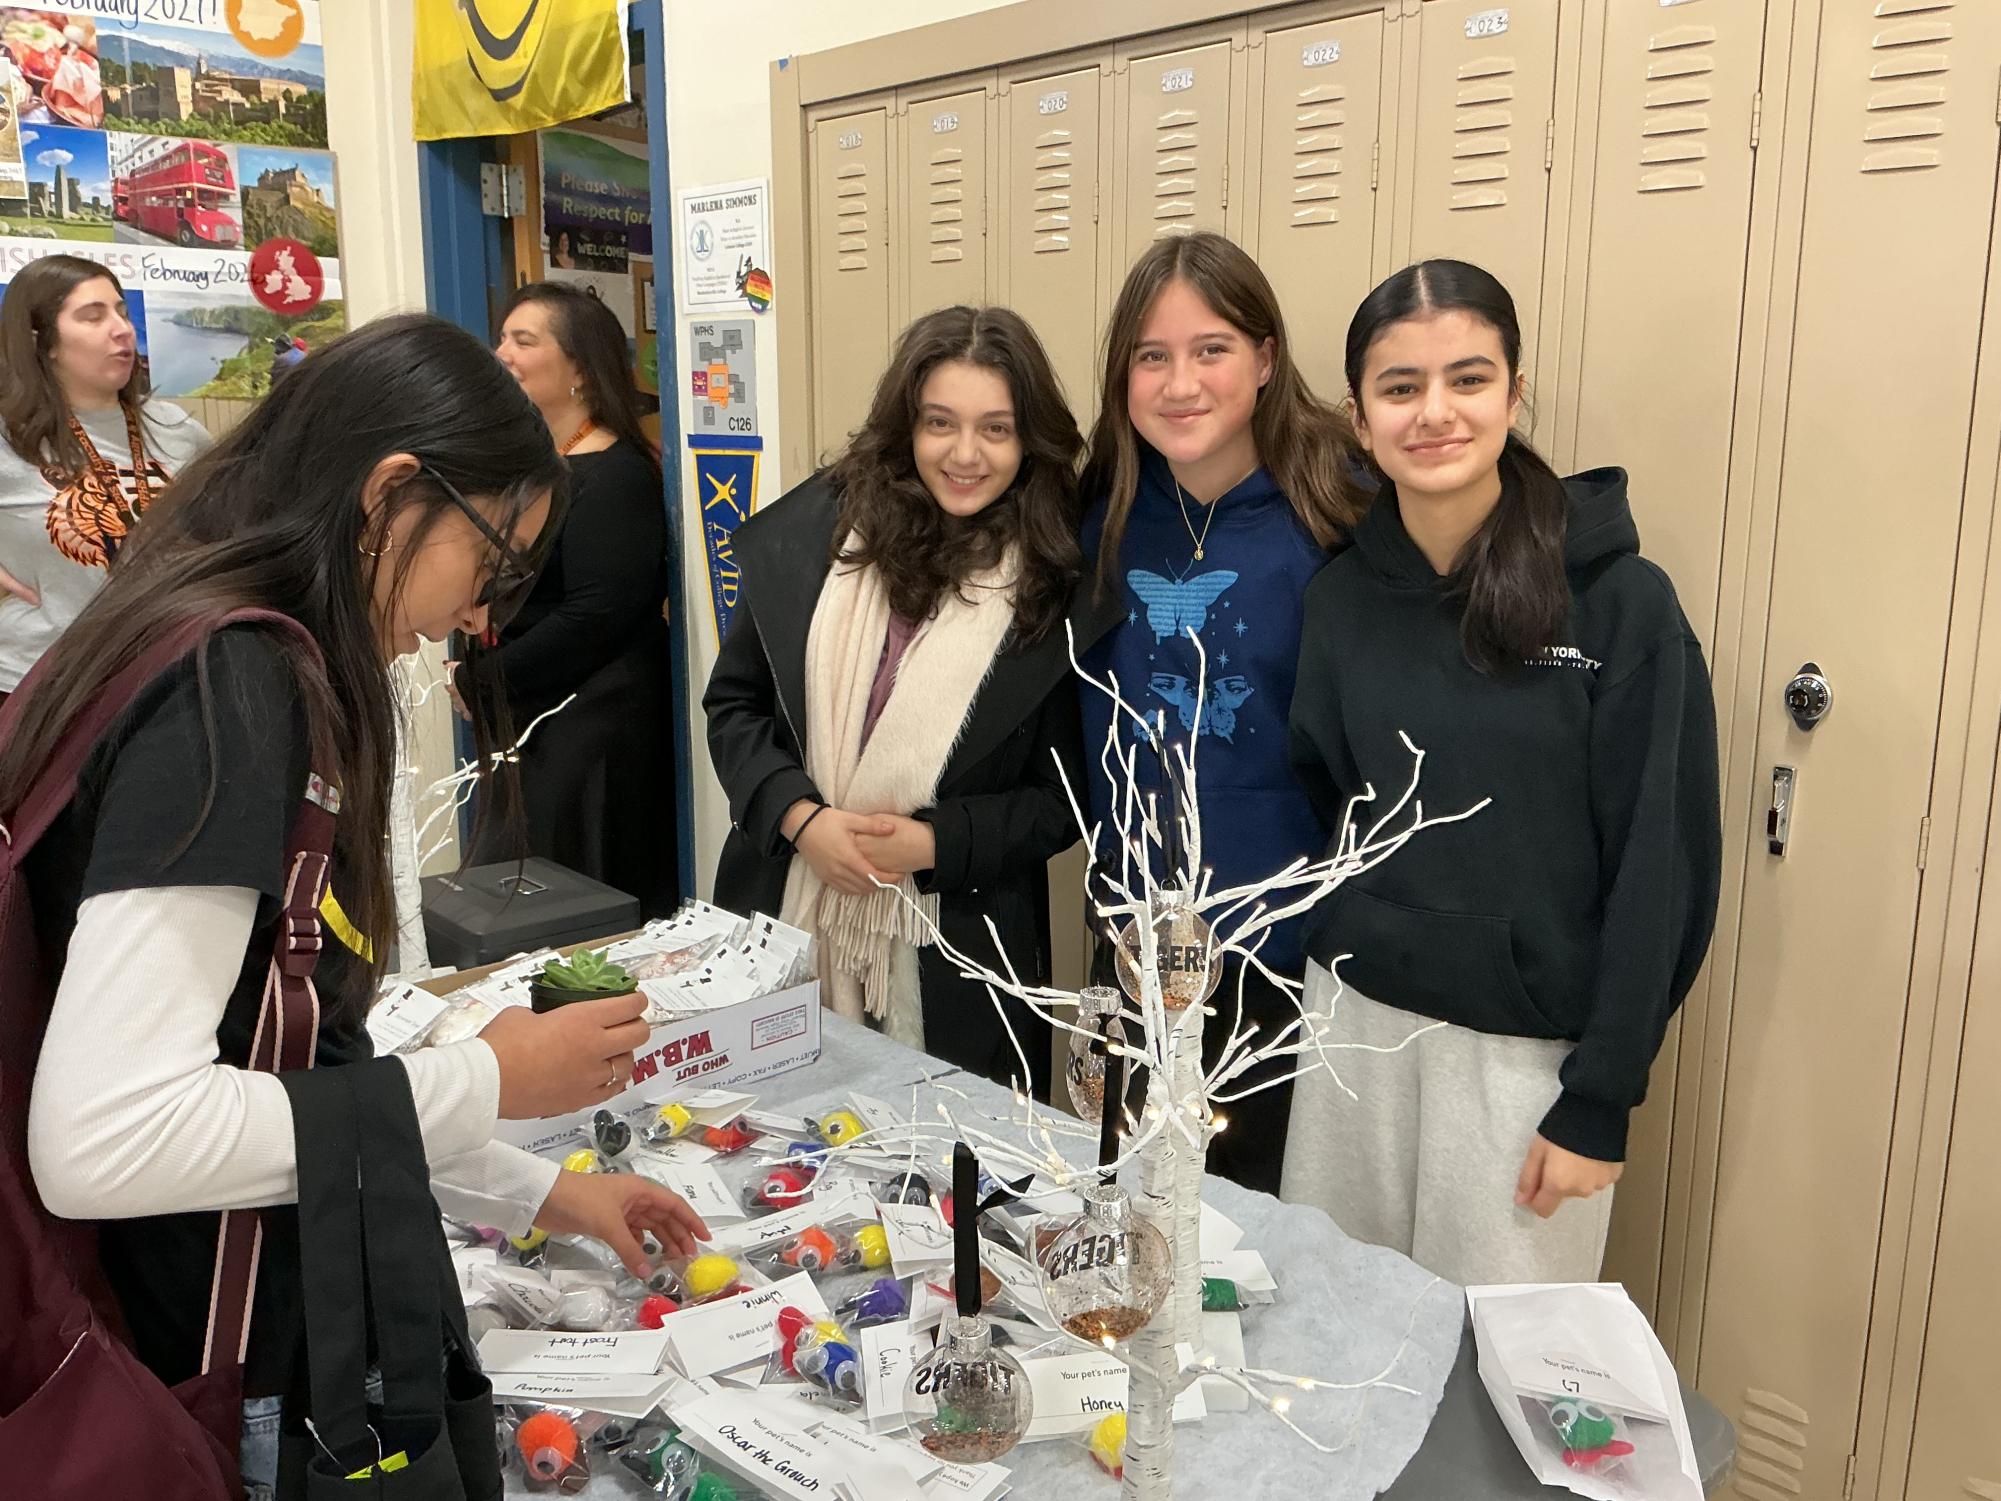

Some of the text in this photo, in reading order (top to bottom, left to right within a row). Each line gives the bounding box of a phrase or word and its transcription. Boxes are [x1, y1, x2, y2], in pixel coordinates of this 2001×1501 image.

[1478, 16, 1505, 34] 023
[1312, 47, 1335, 63] 022
[1170, 75, 1189, 90] 021
[1046, 97, 1063, 112] 020
[940, 117, 956, 130] 019
[560, 172, 608, 196] Please
[562, 197, 646, 226] Respect for
[690, 194, 758, 215] MARLENA SIMMONS
[576, 242, 626, 258] WELCOME
[142, 252, 210, 290] February
[693, 325, 715, 337] WPHS
[728, 416, 752, 432] C126
[713, 521, 742, 608] AVID
[1129, 946, 1213, 973] TGERS
[675, 1053, 730, 1082] WHO BUT
[755, 1066, 768, 1077] FAX
[772, 1056, 797, 1071] LASER
[742, 1290, 785, 1308] Winnie
[581, 1336, 619, 1348] Frost
[880, 1348, 901, 1378] Cookie
[1542, 1357, 1560, 1368] Your
[1561, 1362, 1580, 1373] pet's
[1581, 1367, 1603, 1379] name
[1060, 1366, 1128, 1381] Your pet's name
[513, 1382, 574, 1394] Pumpkin
[1080, 1397, 1125, 1413] Honey
[752, 1417, 768, 1431] Your
[767, 1429, 785, 1443] pet's
[784, 1440, 806, 1454] name
[850, 1436, 870, 1450] name
[718, 1424, 820, 1493] Oscar the Grouch
